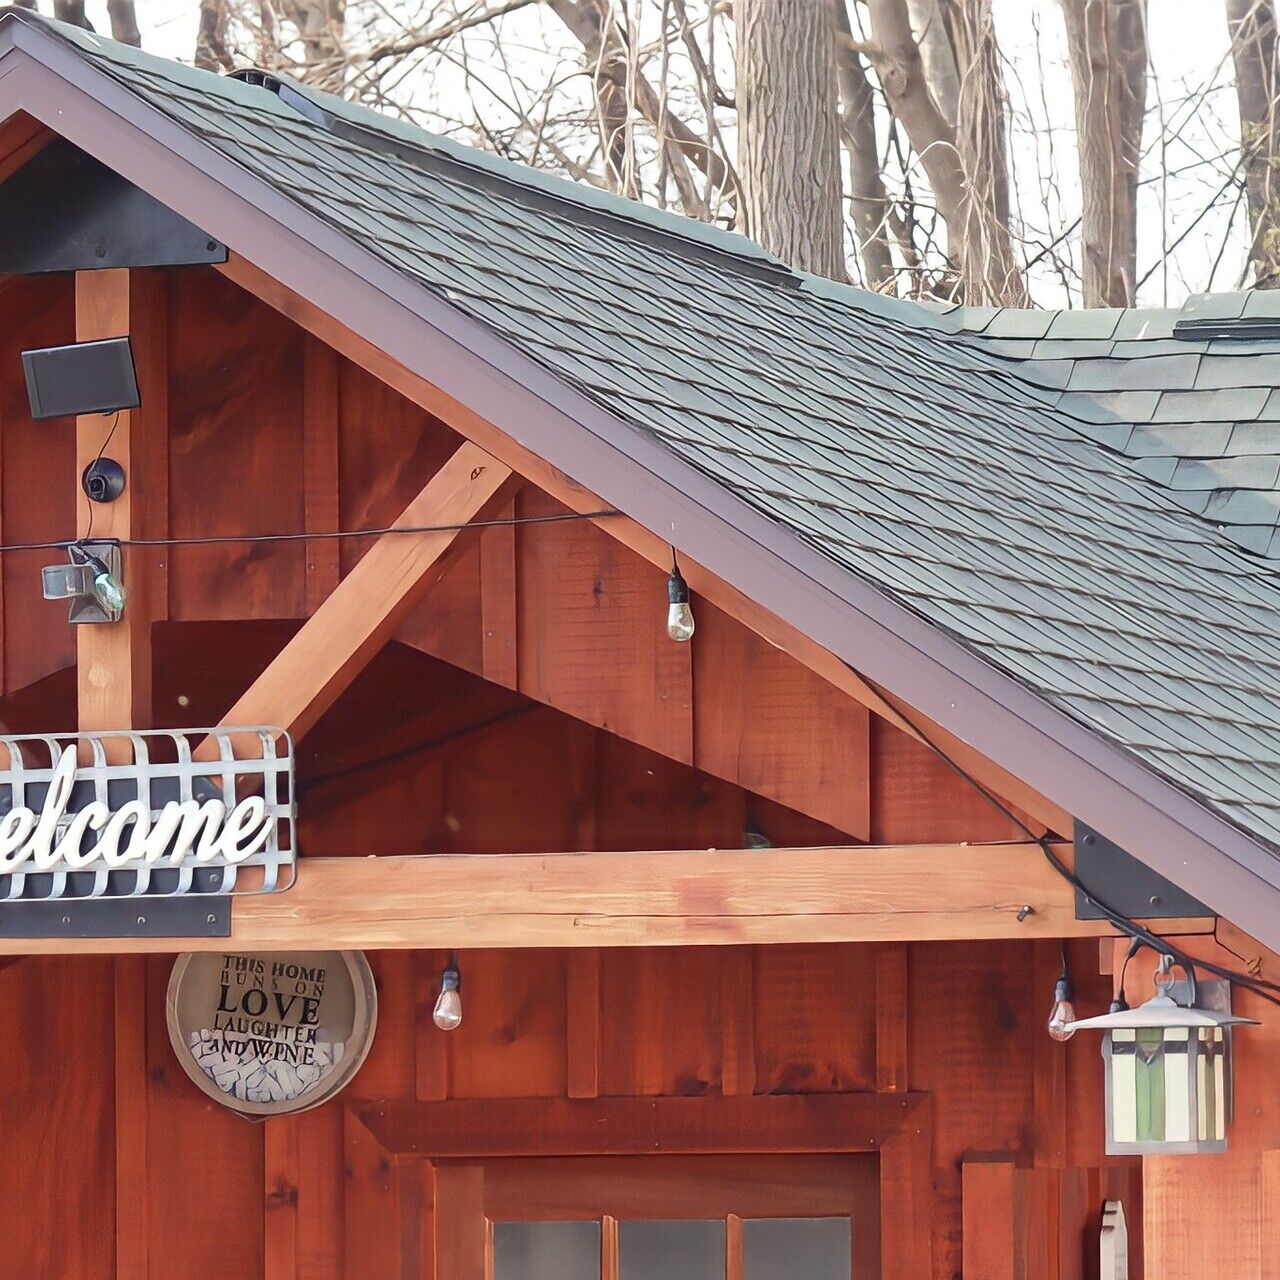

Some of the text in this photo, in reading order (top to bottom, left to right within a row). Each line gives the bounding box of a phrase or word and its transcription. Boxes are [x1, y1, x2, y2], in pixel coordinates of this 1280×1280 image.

[224, 955, 325, 983] THIS HOME
[295, 980, 324, 998] ON
[217, 985, 320, 1025] LOVE
[214, 1013, 318, 1045] LAUGHTER
[248, 1038, 315, 1066] WINE
